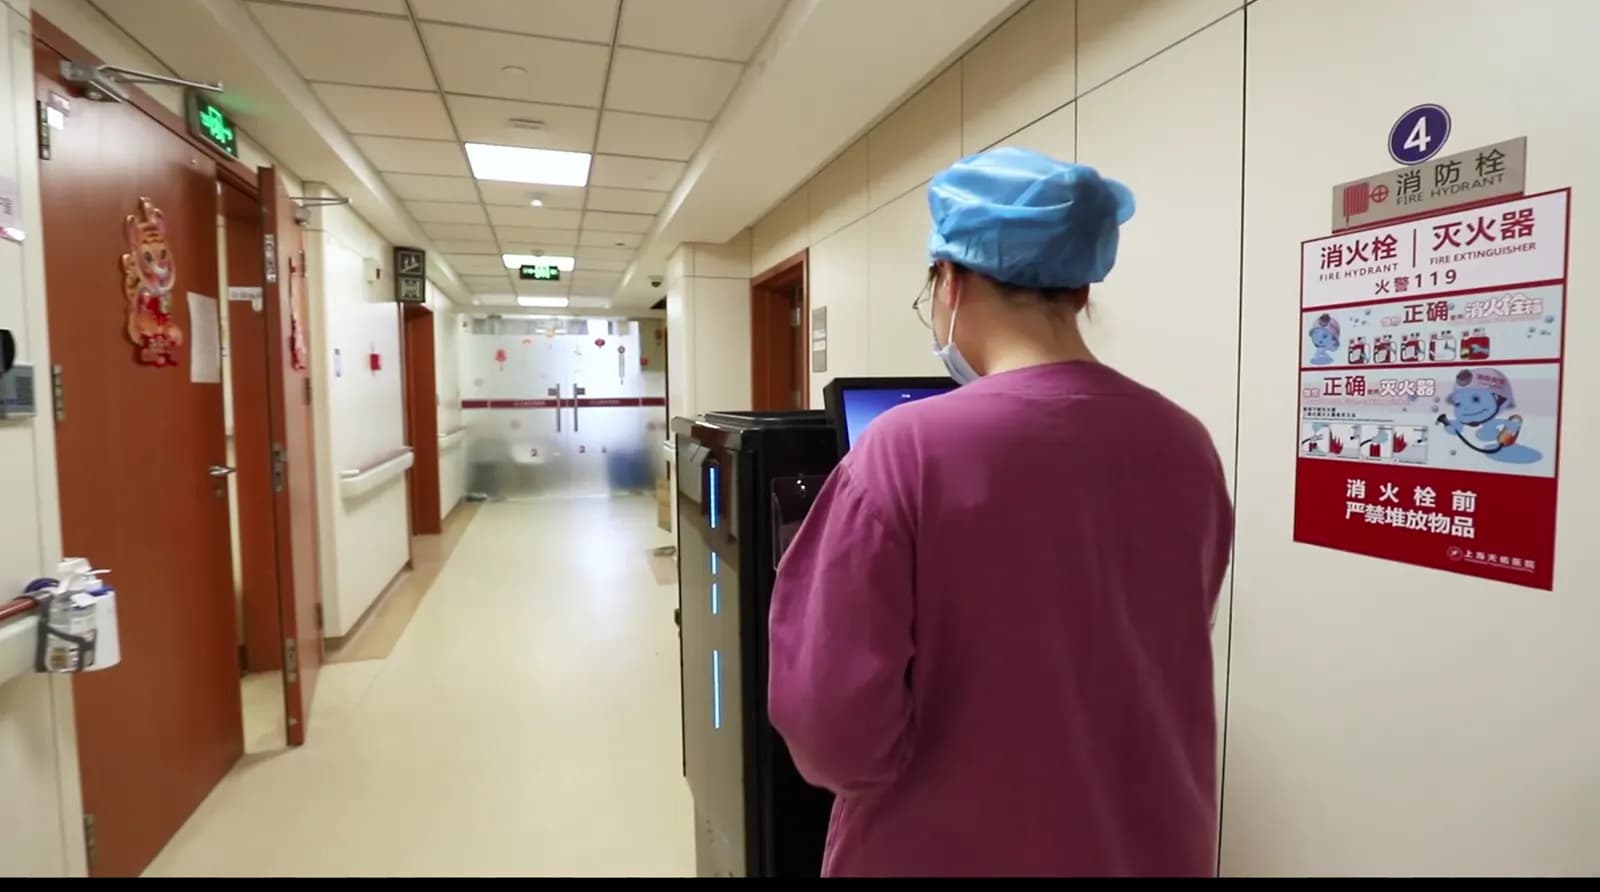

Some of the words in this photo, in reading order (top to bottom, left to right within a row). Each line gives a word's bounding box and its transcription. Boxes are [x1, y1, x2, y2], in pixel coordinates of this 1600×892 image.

[1403, 116, 1431, 153] 4
[1396, 149, 1506, 196] 消防栓
[1397, 191, 1424, 206] FIRE
[1430, 174, 1504, 199] HYDRANT
[1432, 208, 1535, 251] 灭火器
[1320, 234, 1398, 270] 消火栓
[1429, 254, 1451, 265] FIRE
[1453, 242, 1537, 262] EXTINGUISHER
[1319, 271, 1340, 282] FIRE
[1344, 263, 1399, 279] HYDRANT
[1346, 479, 1477, 513] 消火栓前
[1346, 501, 1475, 538] 严禁堆放物品
